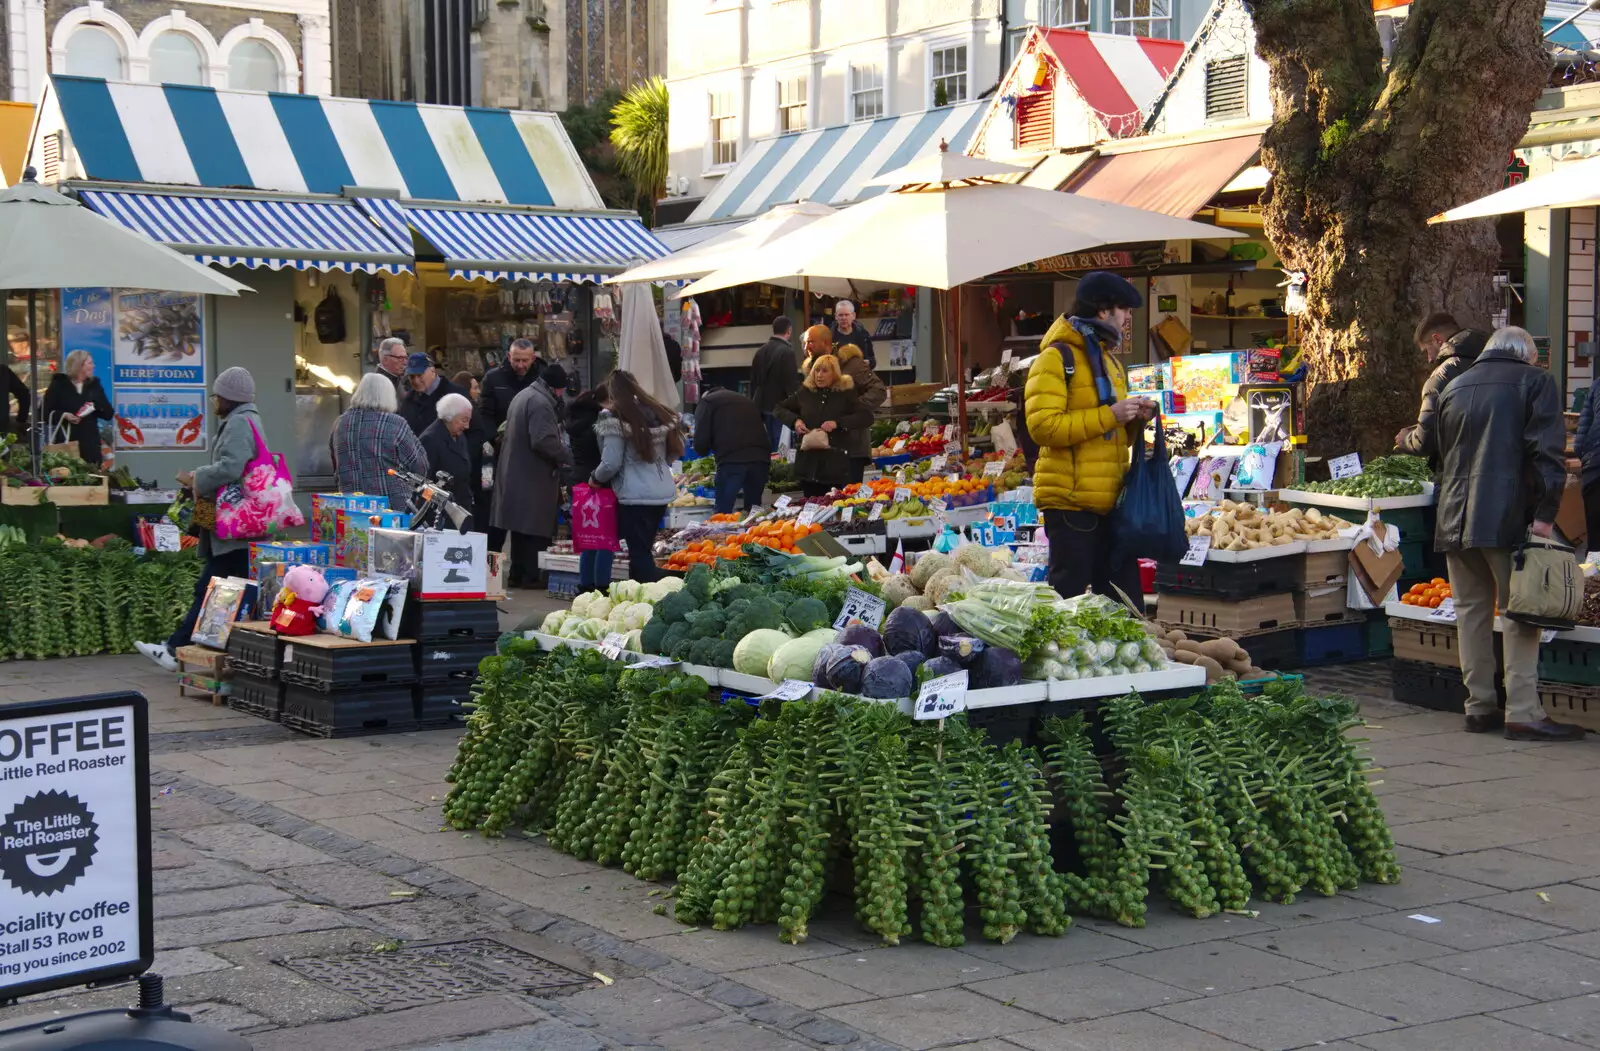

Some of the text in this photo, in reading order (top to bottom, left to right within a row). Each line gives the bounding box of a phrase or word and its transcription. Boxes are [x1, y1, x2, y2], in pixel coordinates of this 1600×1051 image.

[1043, 255, 1076, 270] FRUIT
[1079, 253, 1091, 266] &
[1094, 252, 1119, 266] VEG
[73, 308, 106, 323] Day
[119, 369, 197, 379] HERE TODAY
[0, 755, 126, 781] ittle Red Roaster
[13, 813, 81, 833] The Little
[4, 827, 91, 849] Red Roaster
[69, 901, 130, 922] coffee
[32, 935, 52, 950] 53
[58, 931, 90, 945] Row
[93, 925, 104, 938] B
[24, 958, 49, 973] you
[51, 950, 87, 965] since
[90, 940, 126, 958] 2002
